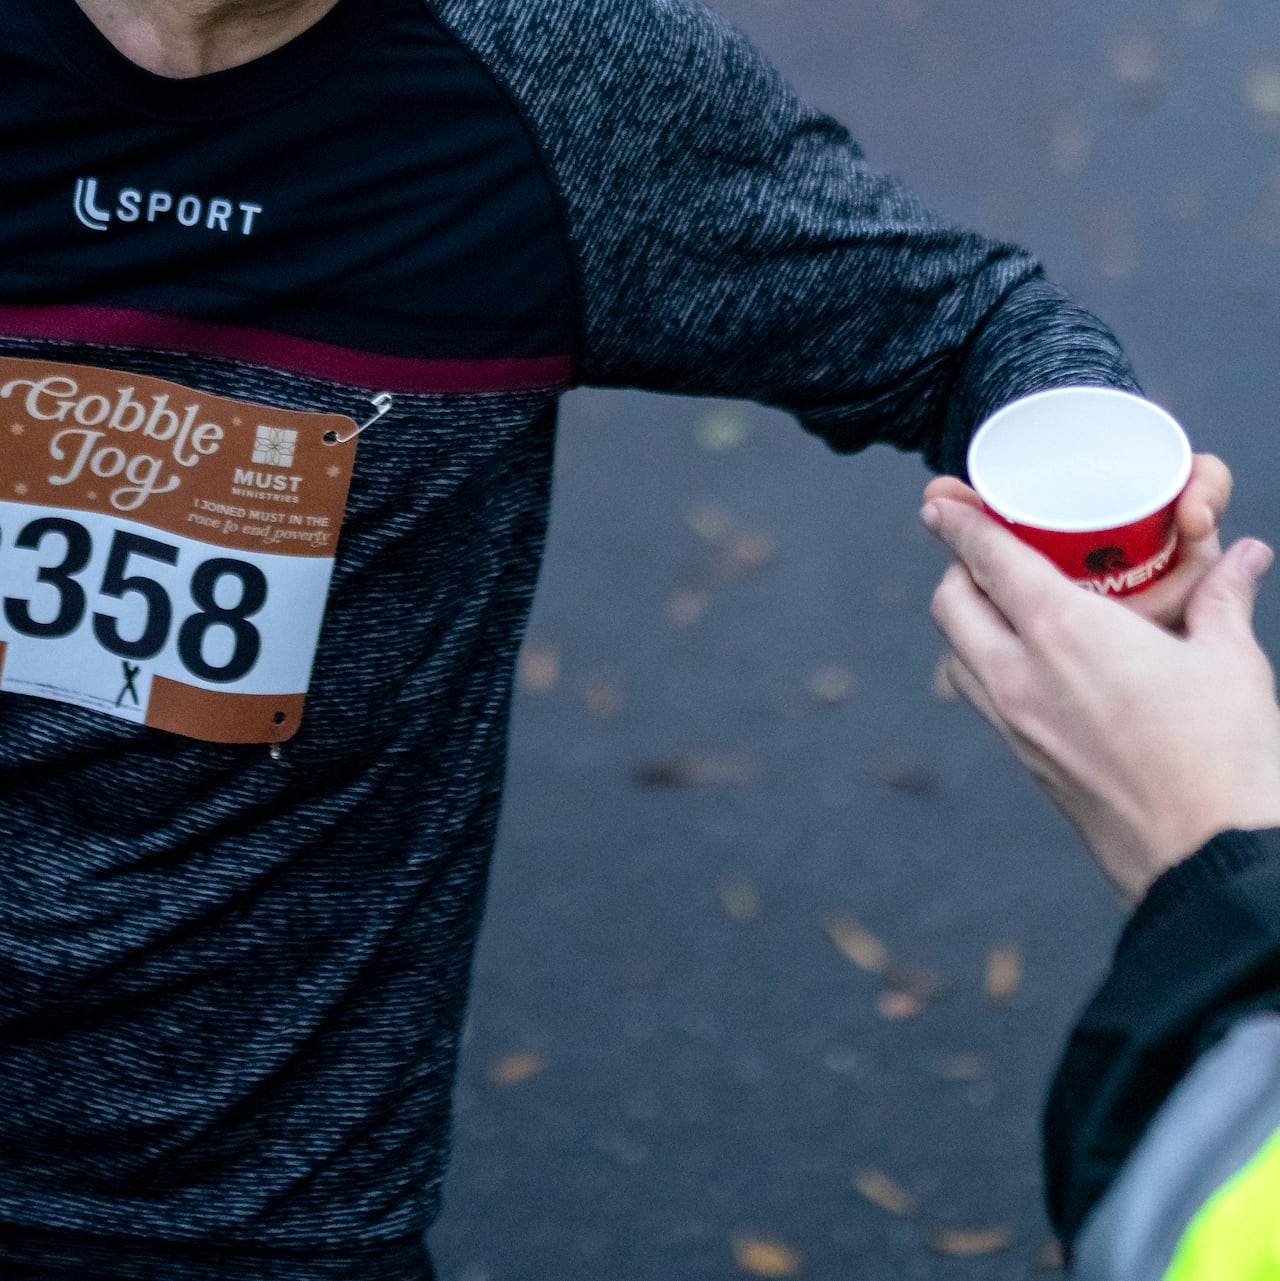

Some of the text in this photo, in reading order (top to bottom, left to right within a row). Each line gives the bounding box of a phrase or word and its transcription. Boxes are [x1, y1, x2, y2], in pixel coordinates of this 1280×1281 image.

[0, 375, 224, 467] Gobble
[48, 428, 182, 511] Jog
[233, 468, 303, 493] MUST
[231, 487, 299, 504] MINISTRIES
[200, 499, 246, 518] JOINED
[248, 510, 286, 523] MUST
[289, 515, 303, 525] IN
[306, 516, 331, 528] THE
[187, 513, 331, 548] race to end poverty
